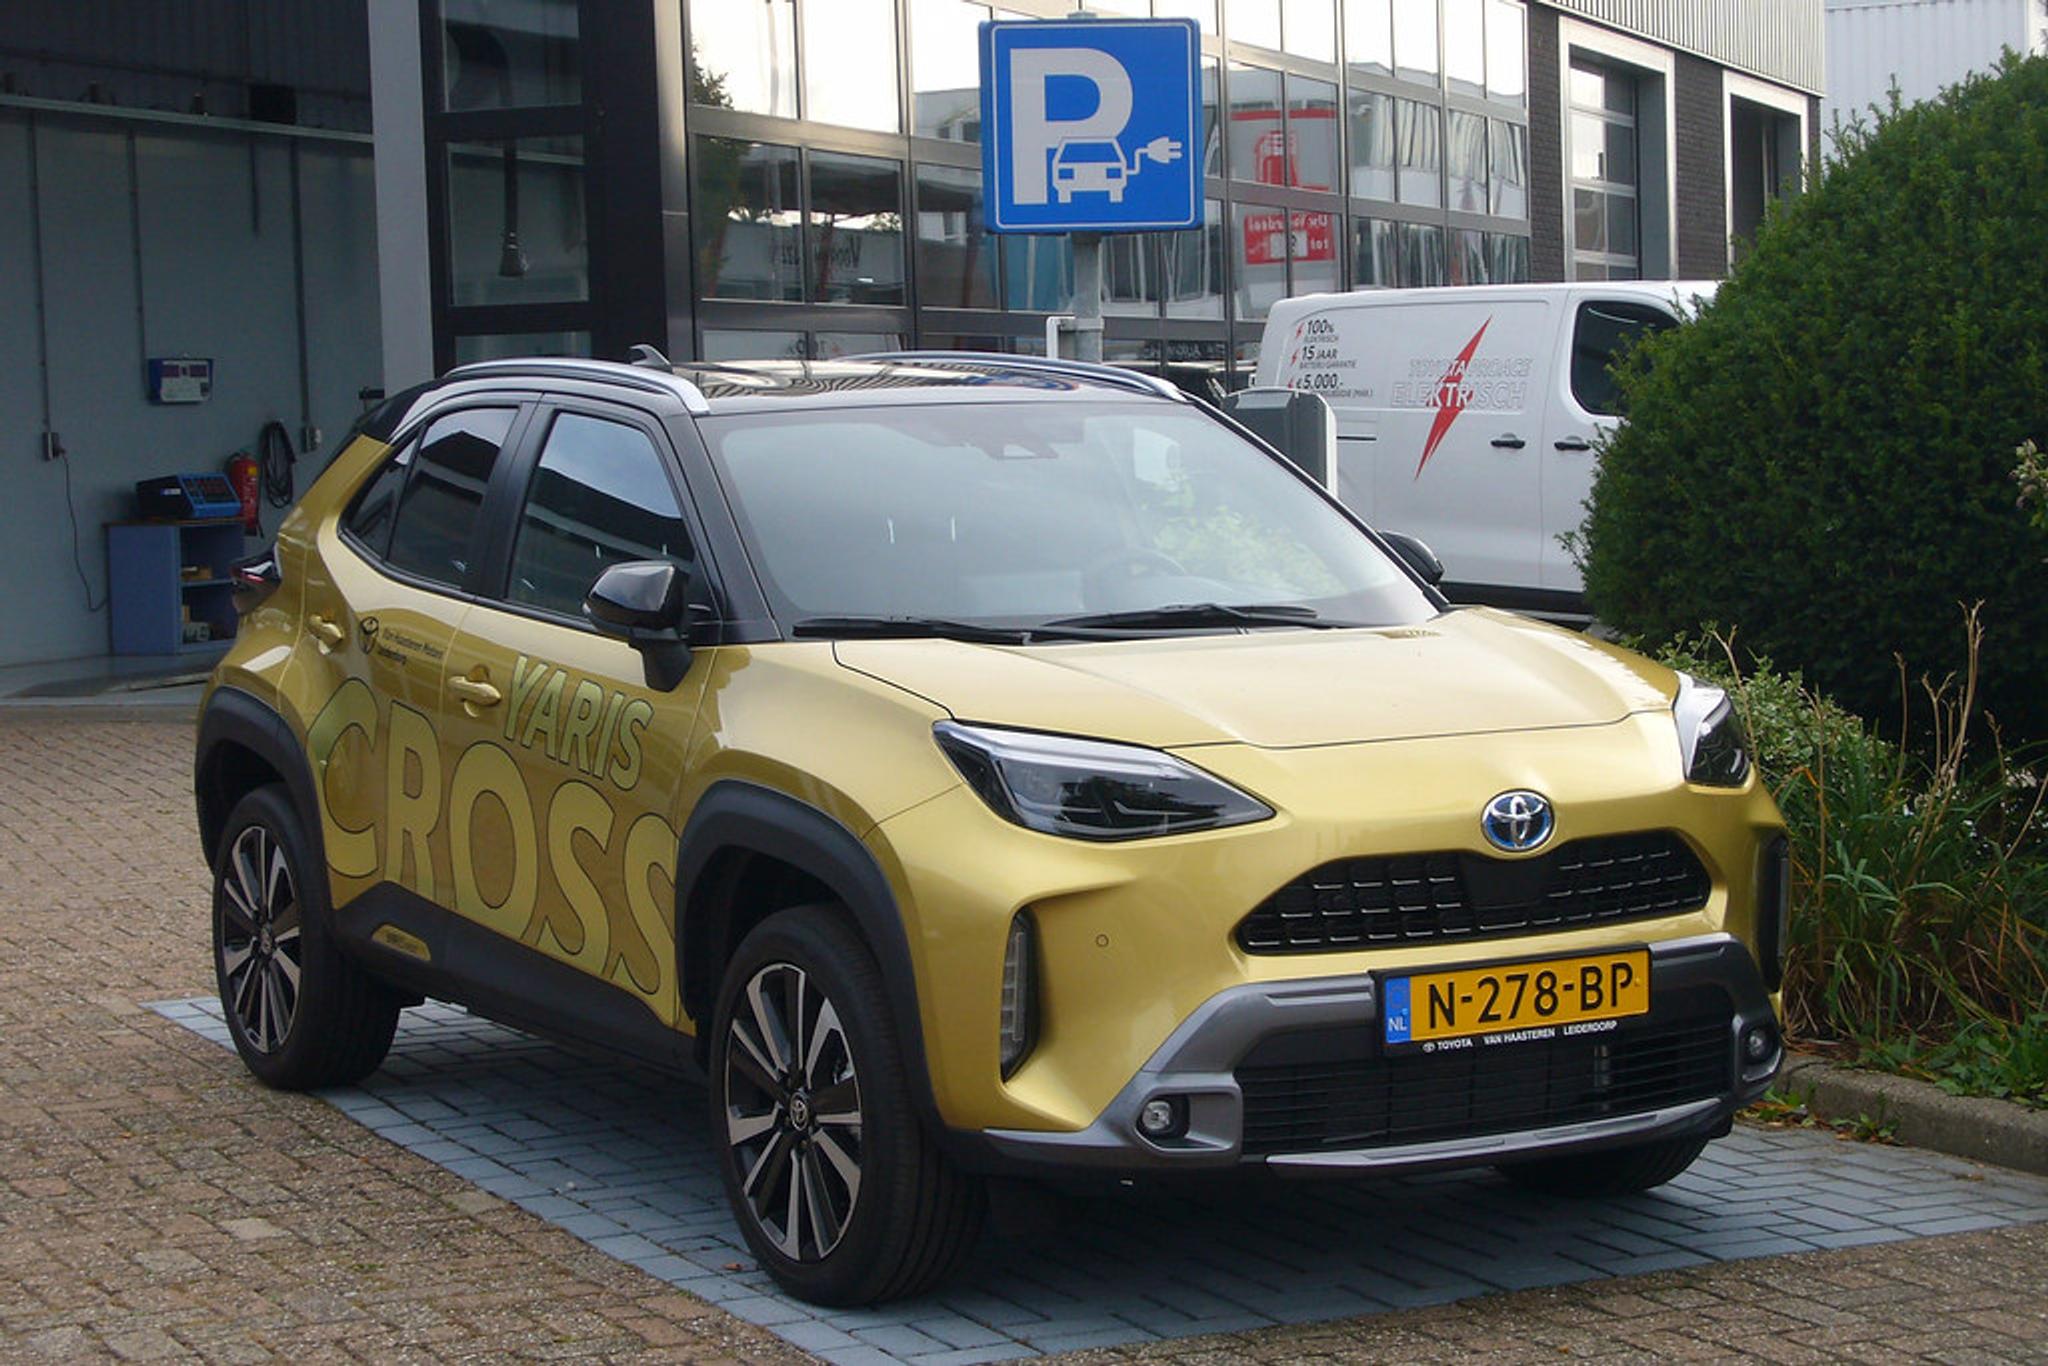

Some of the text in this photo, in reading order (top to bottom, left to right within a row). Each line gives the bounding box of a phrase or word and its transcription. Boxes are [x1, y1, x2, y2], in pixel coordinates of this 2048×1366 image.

[1010, 48, 1134, 205] P
[1307, 319, 1335, 335] 100%
[1302, 345, 1338, 360] 15 JAAR
[1391, 381, 1527, 409] ELEKTRISCH
[504, 654, 654, 792] YARIS
[306, 677, 680, 1026] CROSS
[1428, 961, 1634, 1029] N-278-BP
[1388, 1016, 1408, 1032] NL
[1437, 1020, 1618, 1050] TOYOTA VAN HAASTEREN LEIDERDORP
